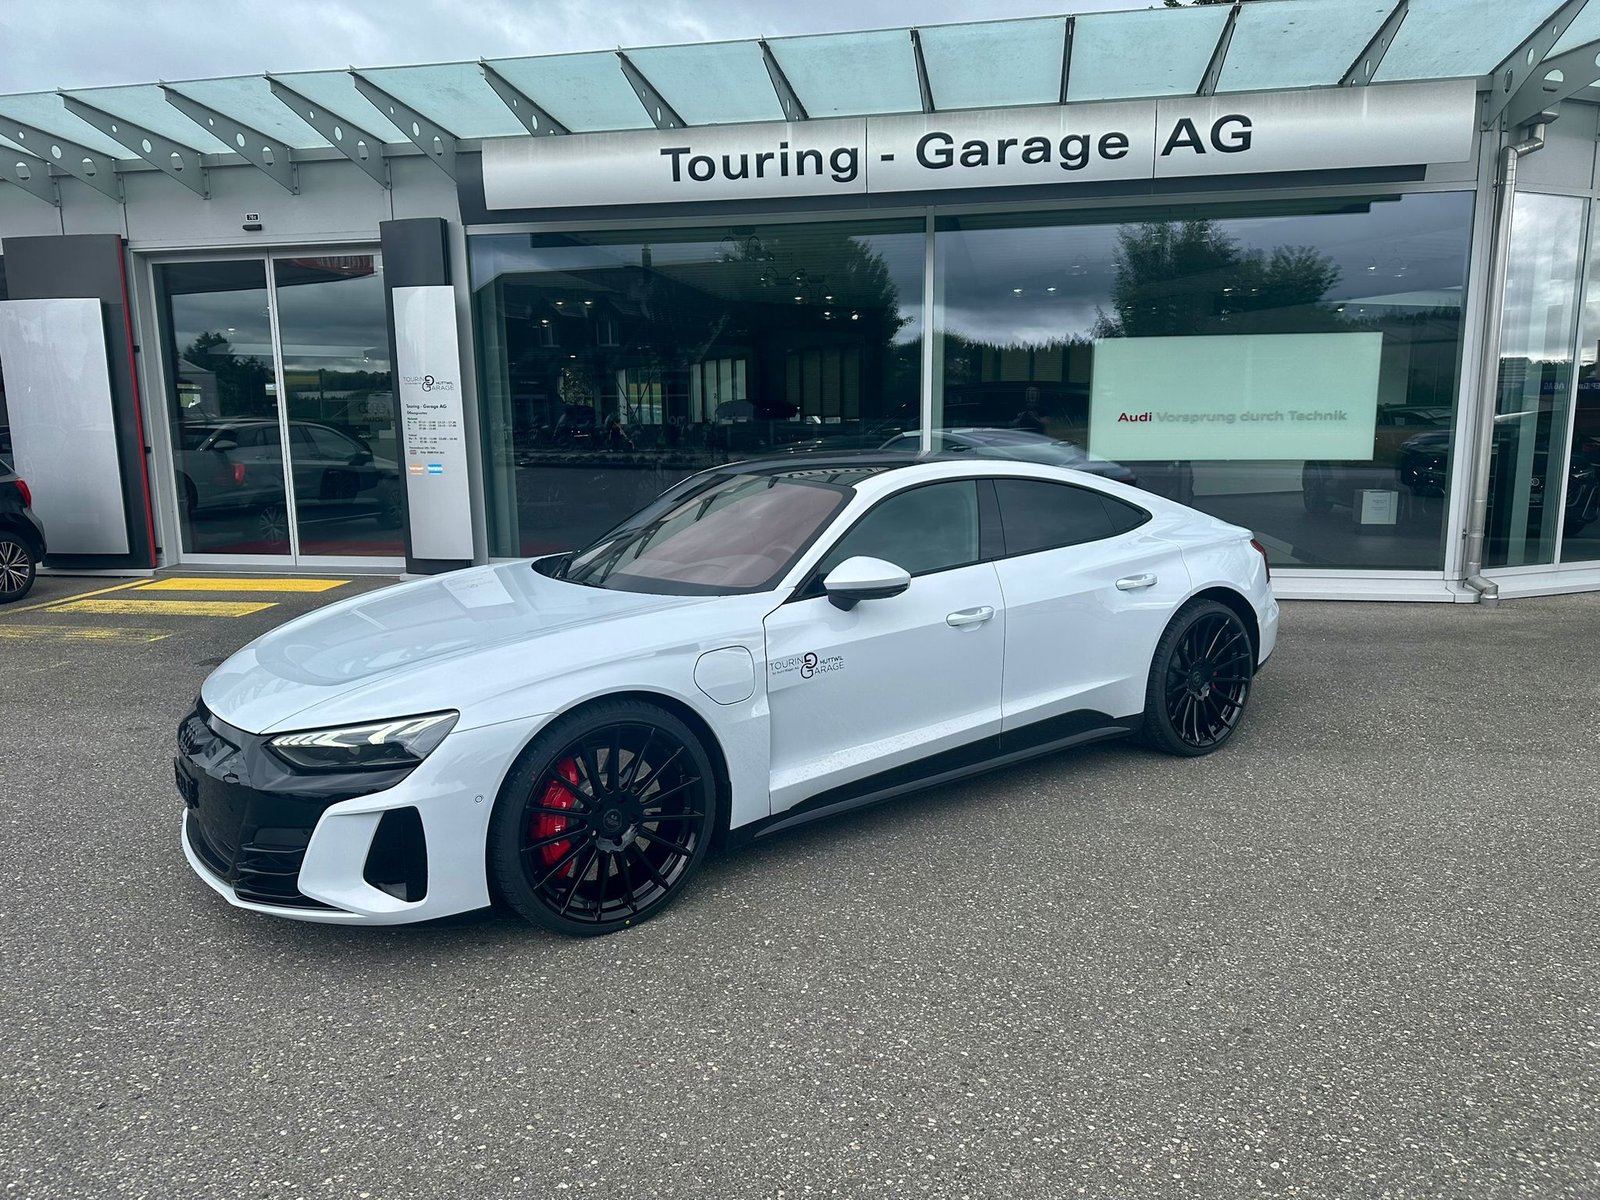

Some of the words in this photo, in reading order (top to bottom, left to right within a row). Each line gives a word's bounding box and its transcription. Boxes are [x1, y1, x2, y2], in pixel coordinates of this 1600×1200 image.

[660, 142, 858, 182] Touring
[915, 131, 1129, 171] Garage
[1160, 114, 1253, 157] AG
[1118, 412, 1152, 422] Audi
[1156, 411, 1236, 424] Vorsprung
[1240, 410, 1284, 422] durch
[1288, 410, 1348, 421] Technik
